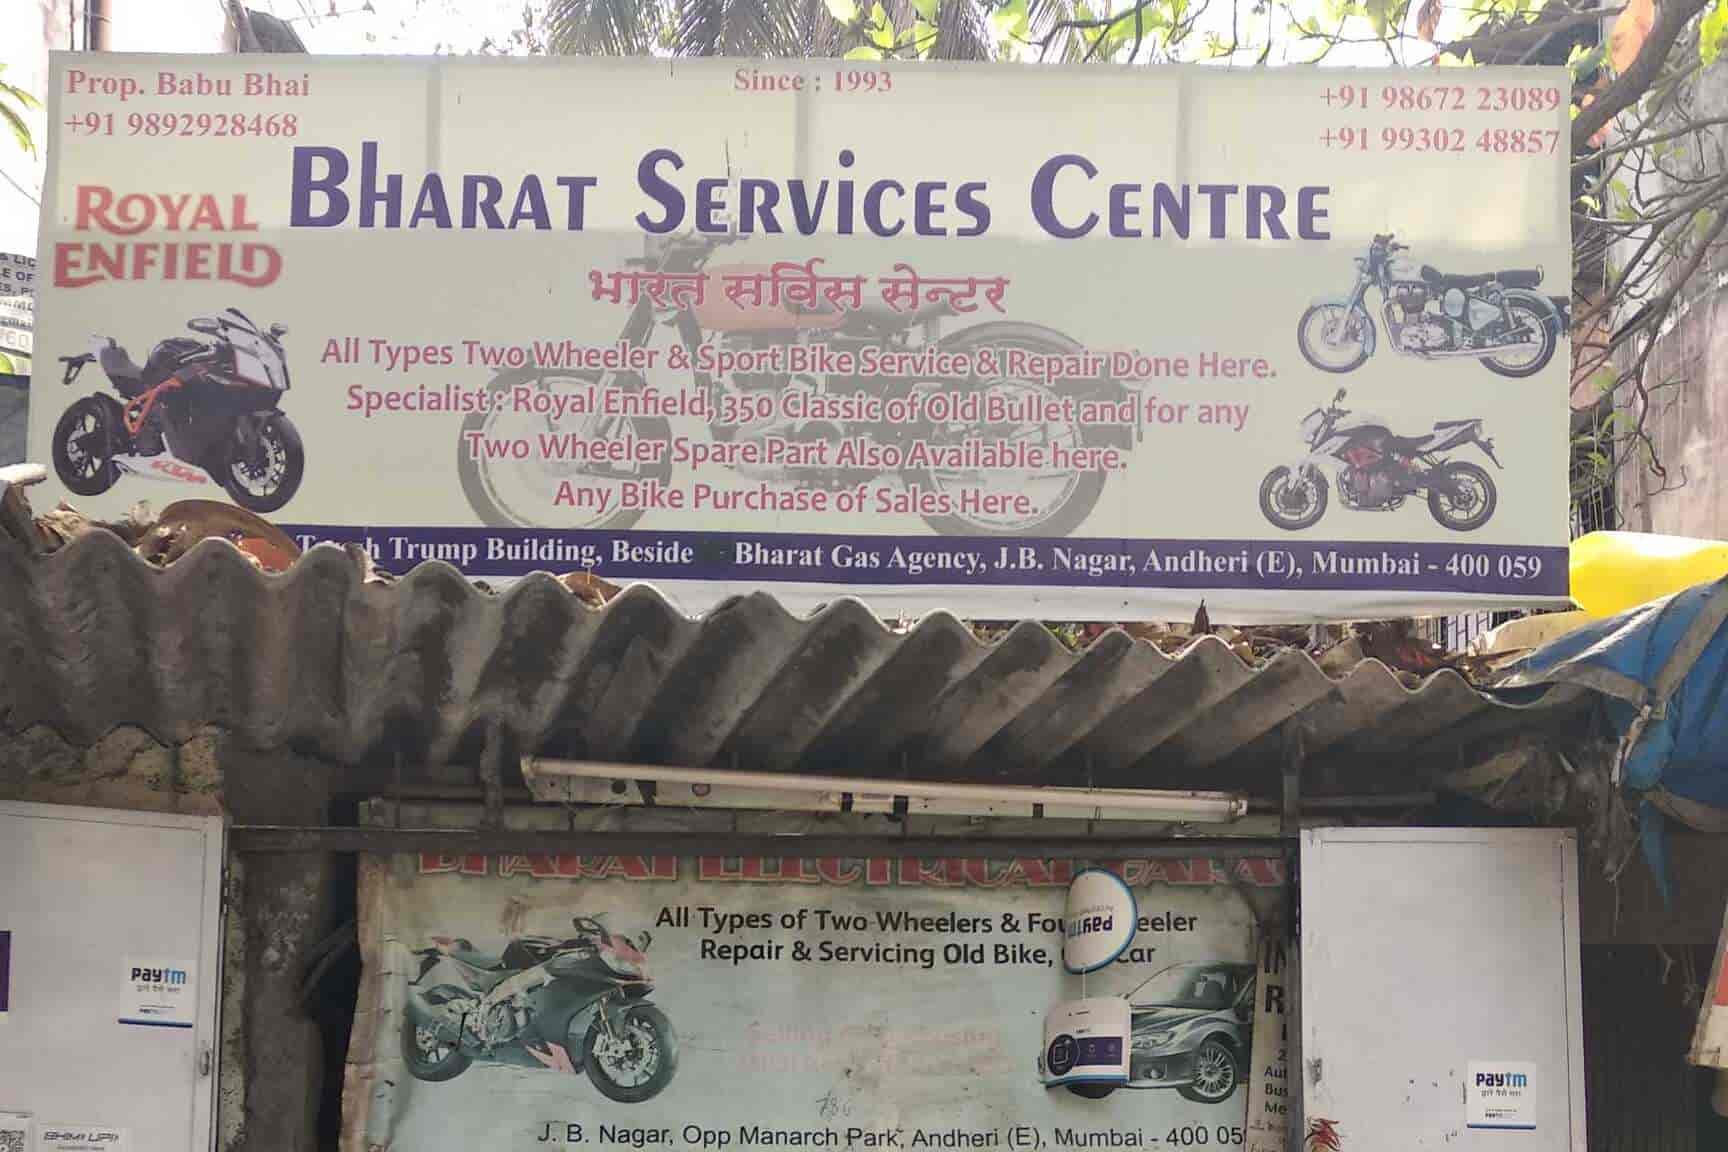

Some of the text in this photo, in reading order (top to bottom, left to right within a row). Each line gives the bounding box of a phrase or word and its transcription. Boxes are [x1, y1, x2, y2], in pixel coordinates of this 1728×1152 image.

[67, 70, 310, 101] Prop. Babu Bhai
[734, 68, 806, 92] Since
[833, 70, 893, 92] 1993
[1319, 85, 1560, 113] +91 98672 23089
[65, 111, 298, 137] +91 9892928468
[1319, 127, 1560, 155] +91 99302 48857
[590, 267, 709, 312] भारत
[320, 337, 1278, 384] All Types Two Wheeler & Sport Bike Service & Repair Done Here.
[346, 384, 488, 417] Specialist
[513, 387, 594, 419] Royal
[604, 387, 715, 423] Enfield,
[724, 397, 772, 425] 350
[782, 393, 880, 421] Classic
[887, 393, 919, 422] of
[926, 394, 979, 423] Old
[986, 395, 1073, 424] Bullet
[1080, 396, 1137, 424] and
[1144, 398, 1189, 424] for
[1198, 403, 1249, 431] any
[467, 433, 1128, 471] Two Wheeler Spare Part Also Available here.
[553, 481, 1039, 516] Any Bike Purchase of Sales Here.
[388, 536, 477, 566] Trump
[486, 537, 602, 566] Building,
[612, 540, 694, 565] Beside
[735, 541, 824, 567] Bharat
[831, 544, 880, 569] Gas
[889, 545, 987, 575] Agency,
[994, 547, 1044, 570] J.B.
[1051, 547, 1136, 576] Nagar,
[1143, 548, 1248, 574] Andheri
[1256, 549, 1303, 578] (E),
[1312, 550, 1420, 575] Mumbai
[1445, 553, 1490, 578] 400
[1498, 555, 1542, 579] 059
[656, 906, 689, 928] All
[697, 907, 772, 934] Types
[781, 908, 807, 930] of
[813, 910, 868, 933] Two
[876, 911, 992, 933] Wheelers
[1000, 913, 1021, 933] &
[701, 940, 782, 966] Repair
[791, 941, 812, 961] &
[819, 943, 934, 968] Servicing
[943, 944, 985, 964] Old
[993, 944, 1053, 968] Bike,
[599, 1125, 673, 1148] Nagar,
[682, 1125, 731, 1149] Opp
[739, 1126, 839, 1147] Manarch
[847, 1128, 905, 1149] Park,
[911, 1128, 998, 1148] Andheri
[1007, 1126, 1046, 1151] (E),
[1055, 1127, 1143, 1147] Mumbai
[1165, 1126, 1209, 1146] 400
[1216, 1126, 1243, 1145] 05
